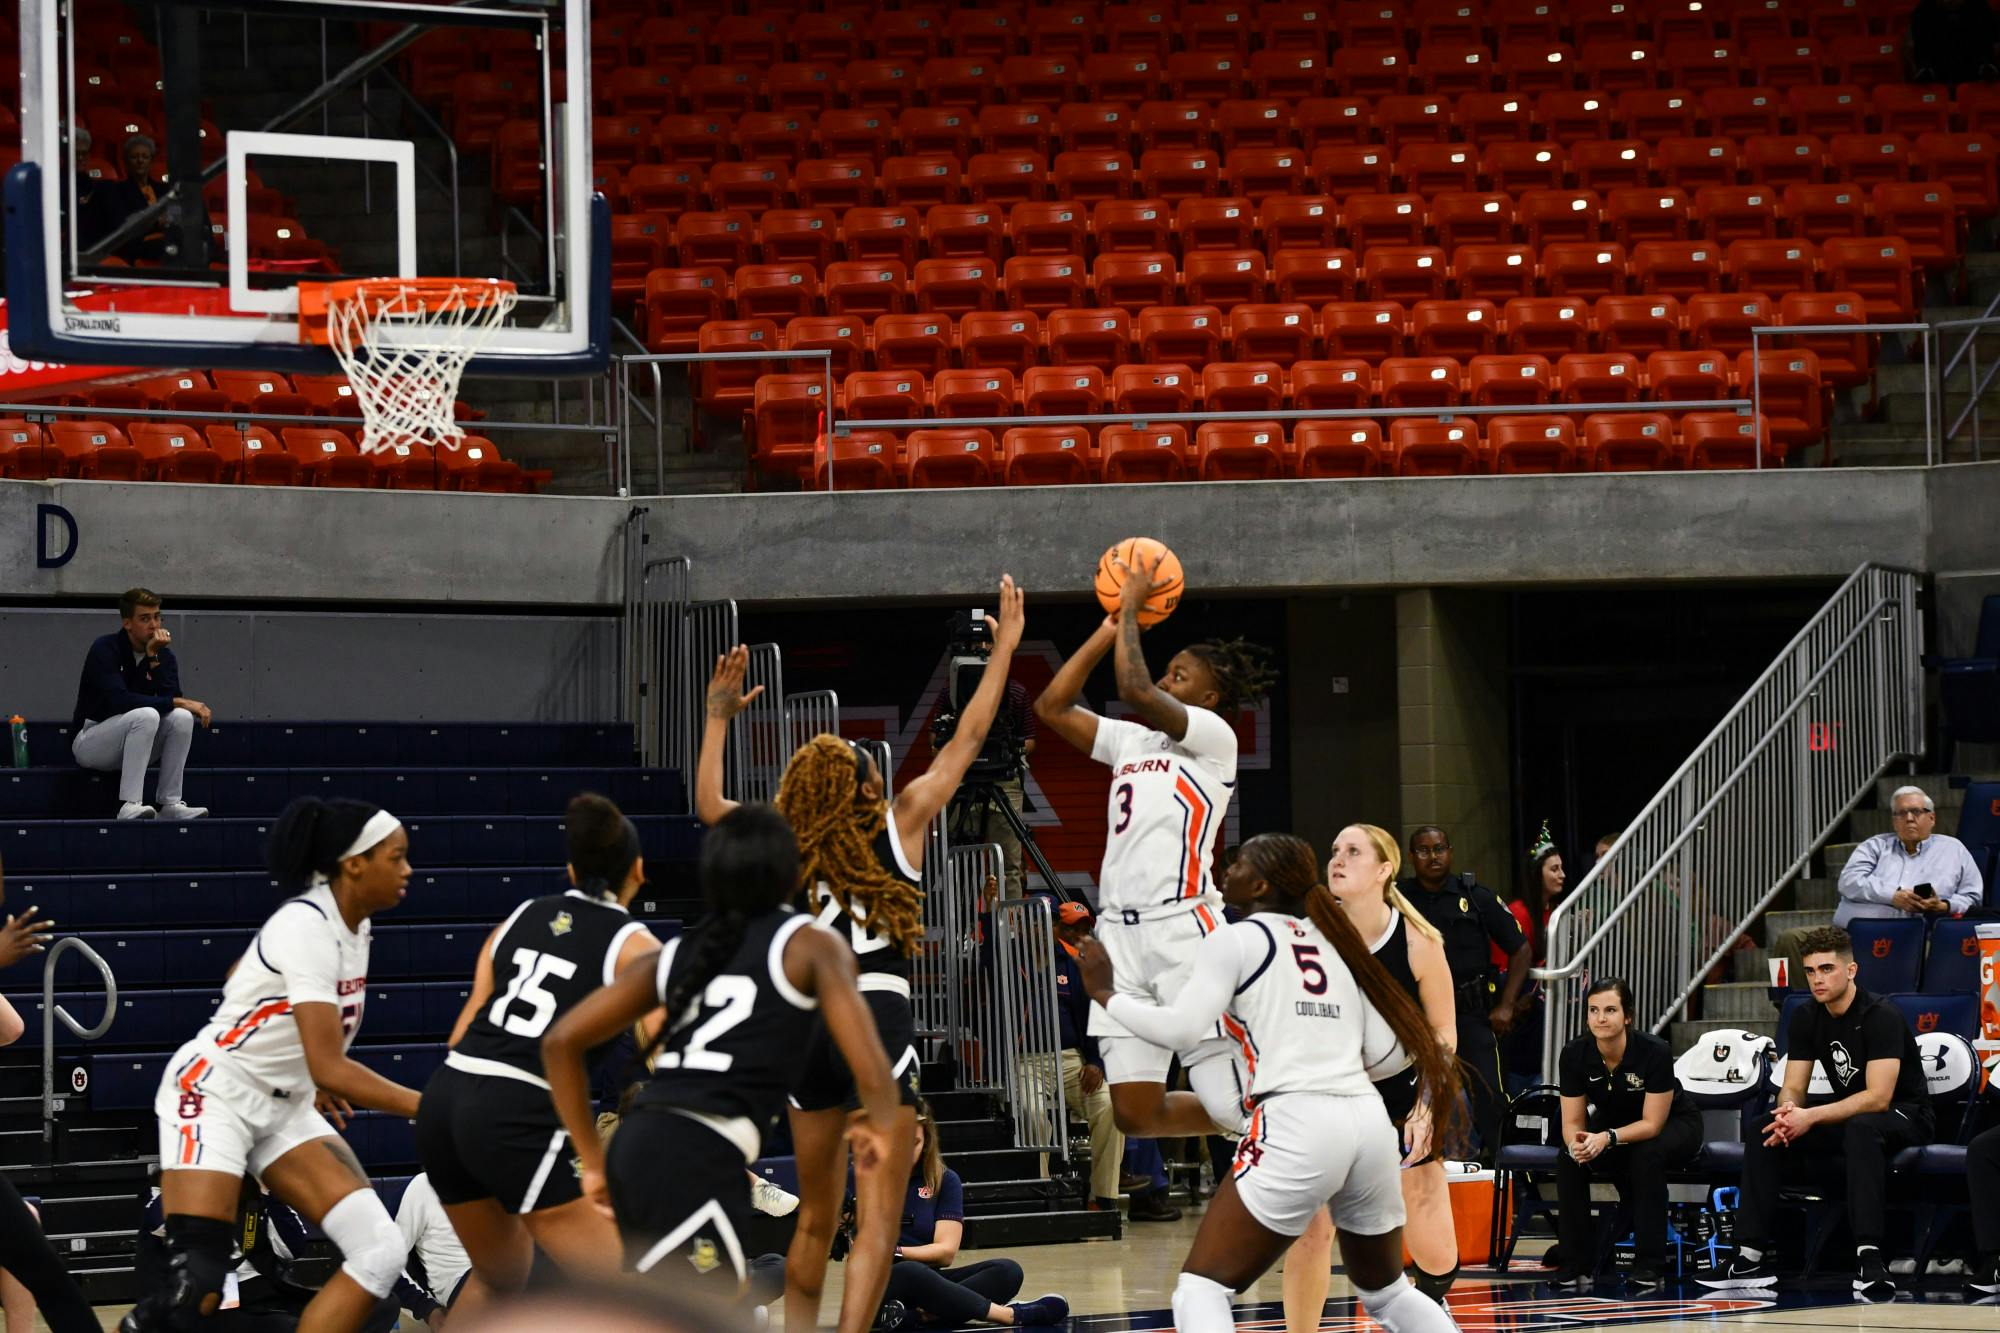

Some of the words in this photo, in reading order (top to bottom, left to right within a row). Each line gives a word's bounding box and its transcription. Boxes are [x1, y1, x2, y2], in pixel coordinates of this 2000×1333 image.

[64, 317, 120, 333] SPALDING
[37, 504, 78, 568] D
[1113, 759, 1171, 779] UBURN
[1114, 782, 1133, 835] 3
[488, 947, 578, 1038] 15
[1291, 943, 1328, 996] 5
[1980, 956, 1994, 985] G
